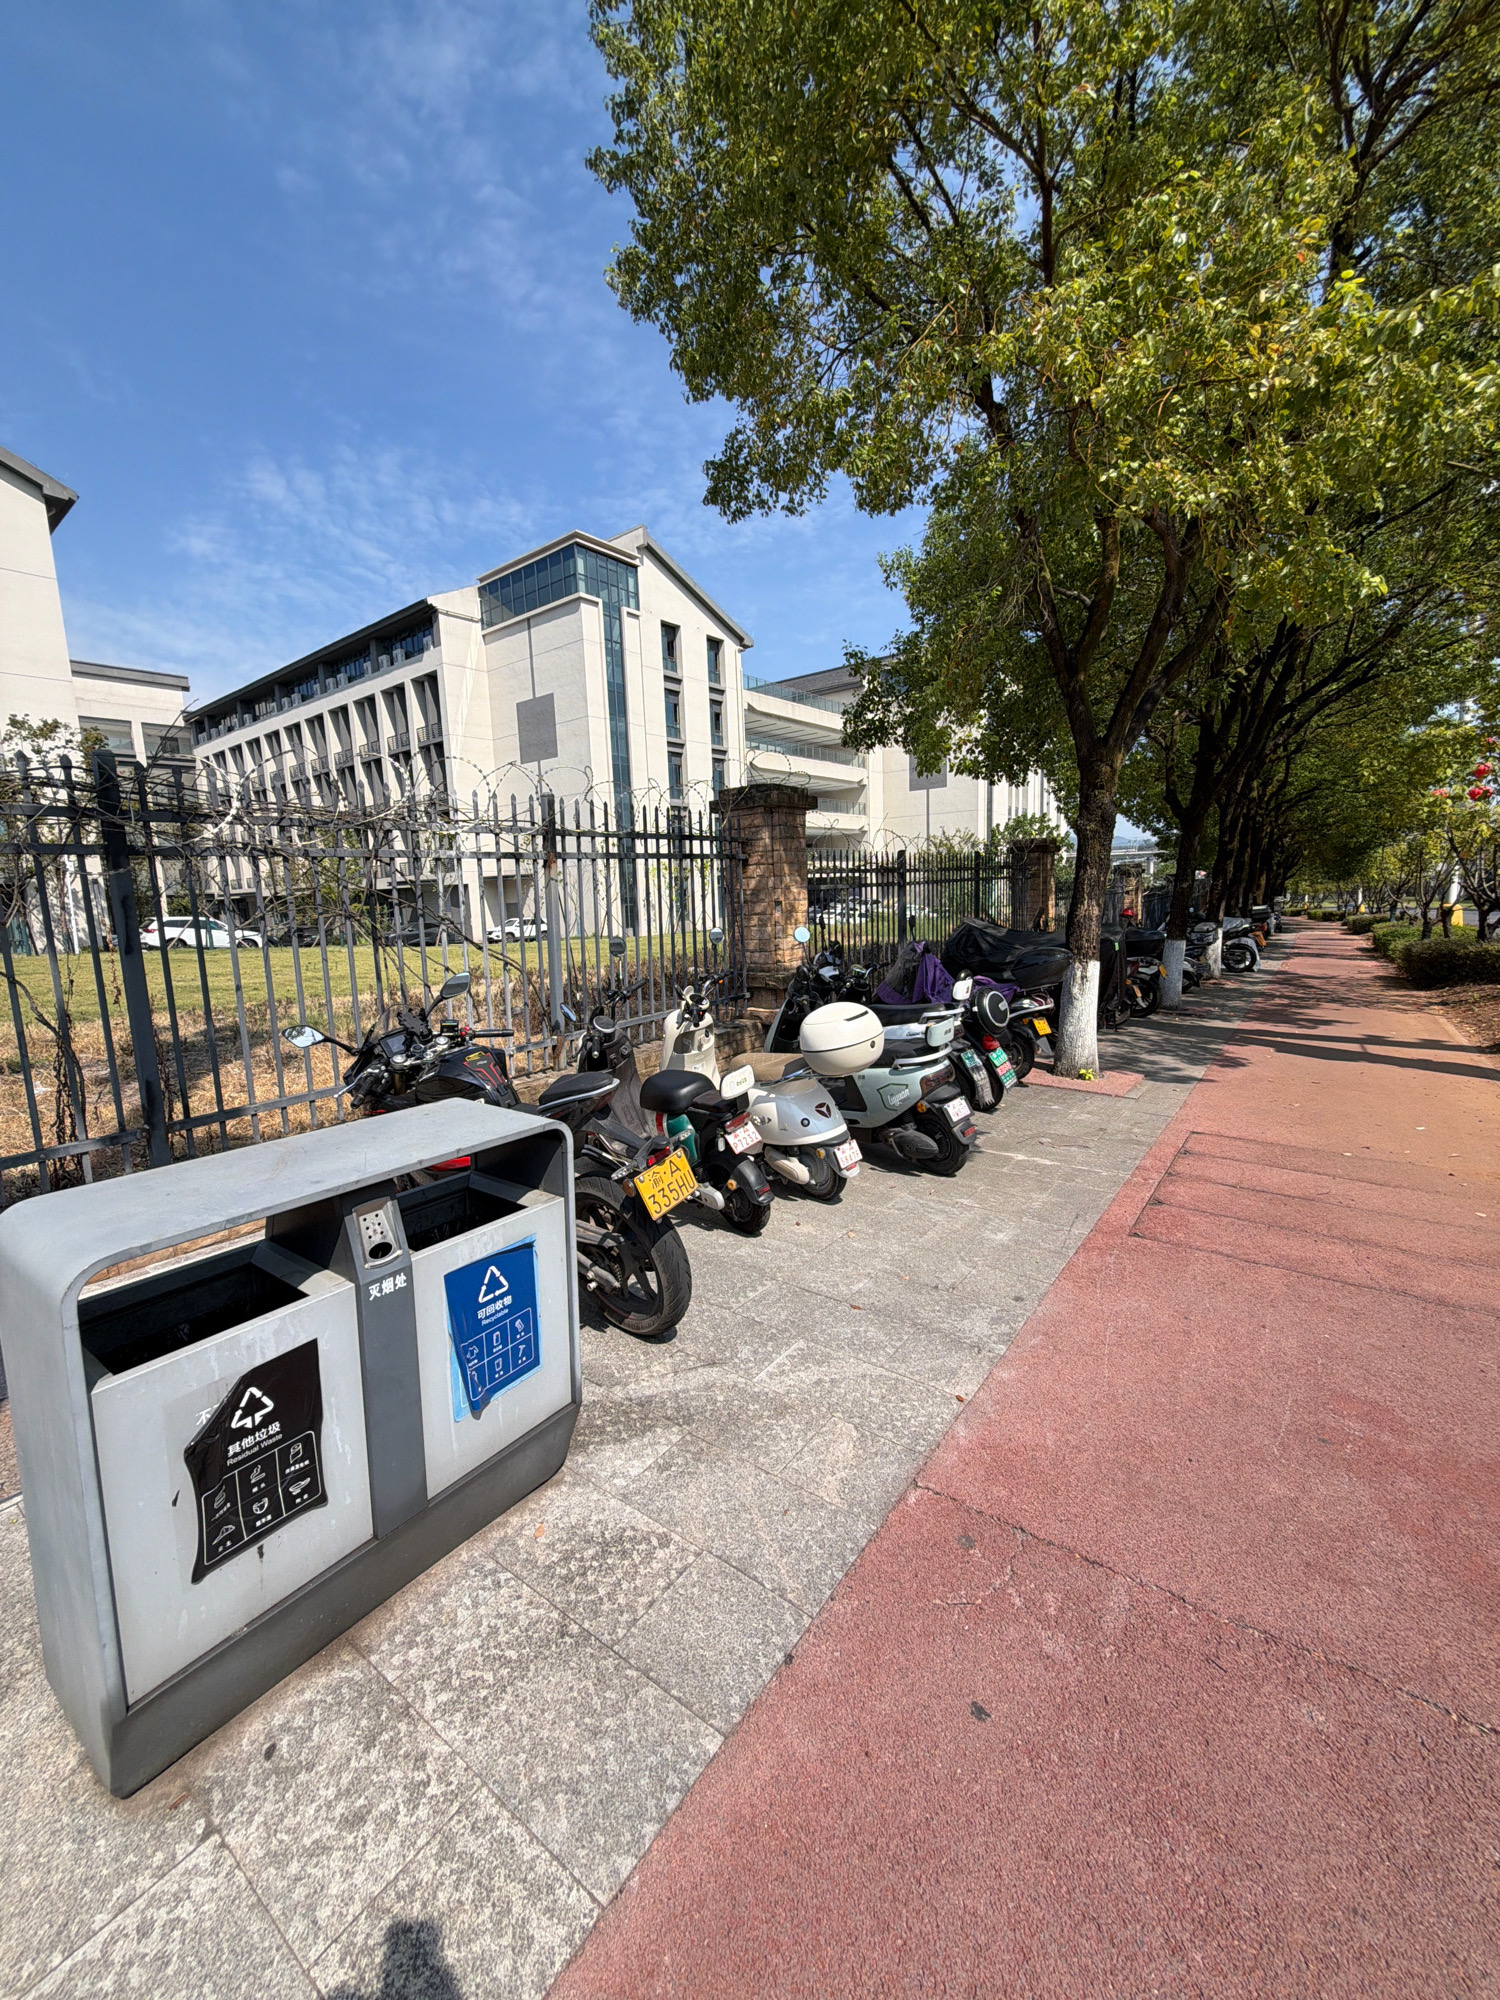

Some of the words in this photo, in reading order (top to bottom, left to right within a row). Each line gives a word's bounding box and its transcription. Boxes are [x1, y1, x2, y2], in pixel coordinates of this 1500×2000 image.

[732, 1132, 759, 1151] P7232
[648, 1160, 682, 1190] 渝·A
[648, 1168, 697, 1214] 335HU
[368, 1272, 408, 1301] 灭烟处
[477, 1295, 513, 1319] 可回收物
[481, 1308, 509, 1326] Recyclable
[227, 1421, 281, 1457] 其他垃圾
[227, 1444, 260, 1466] Residual
[260, 1433, 283, 1450] Waste
